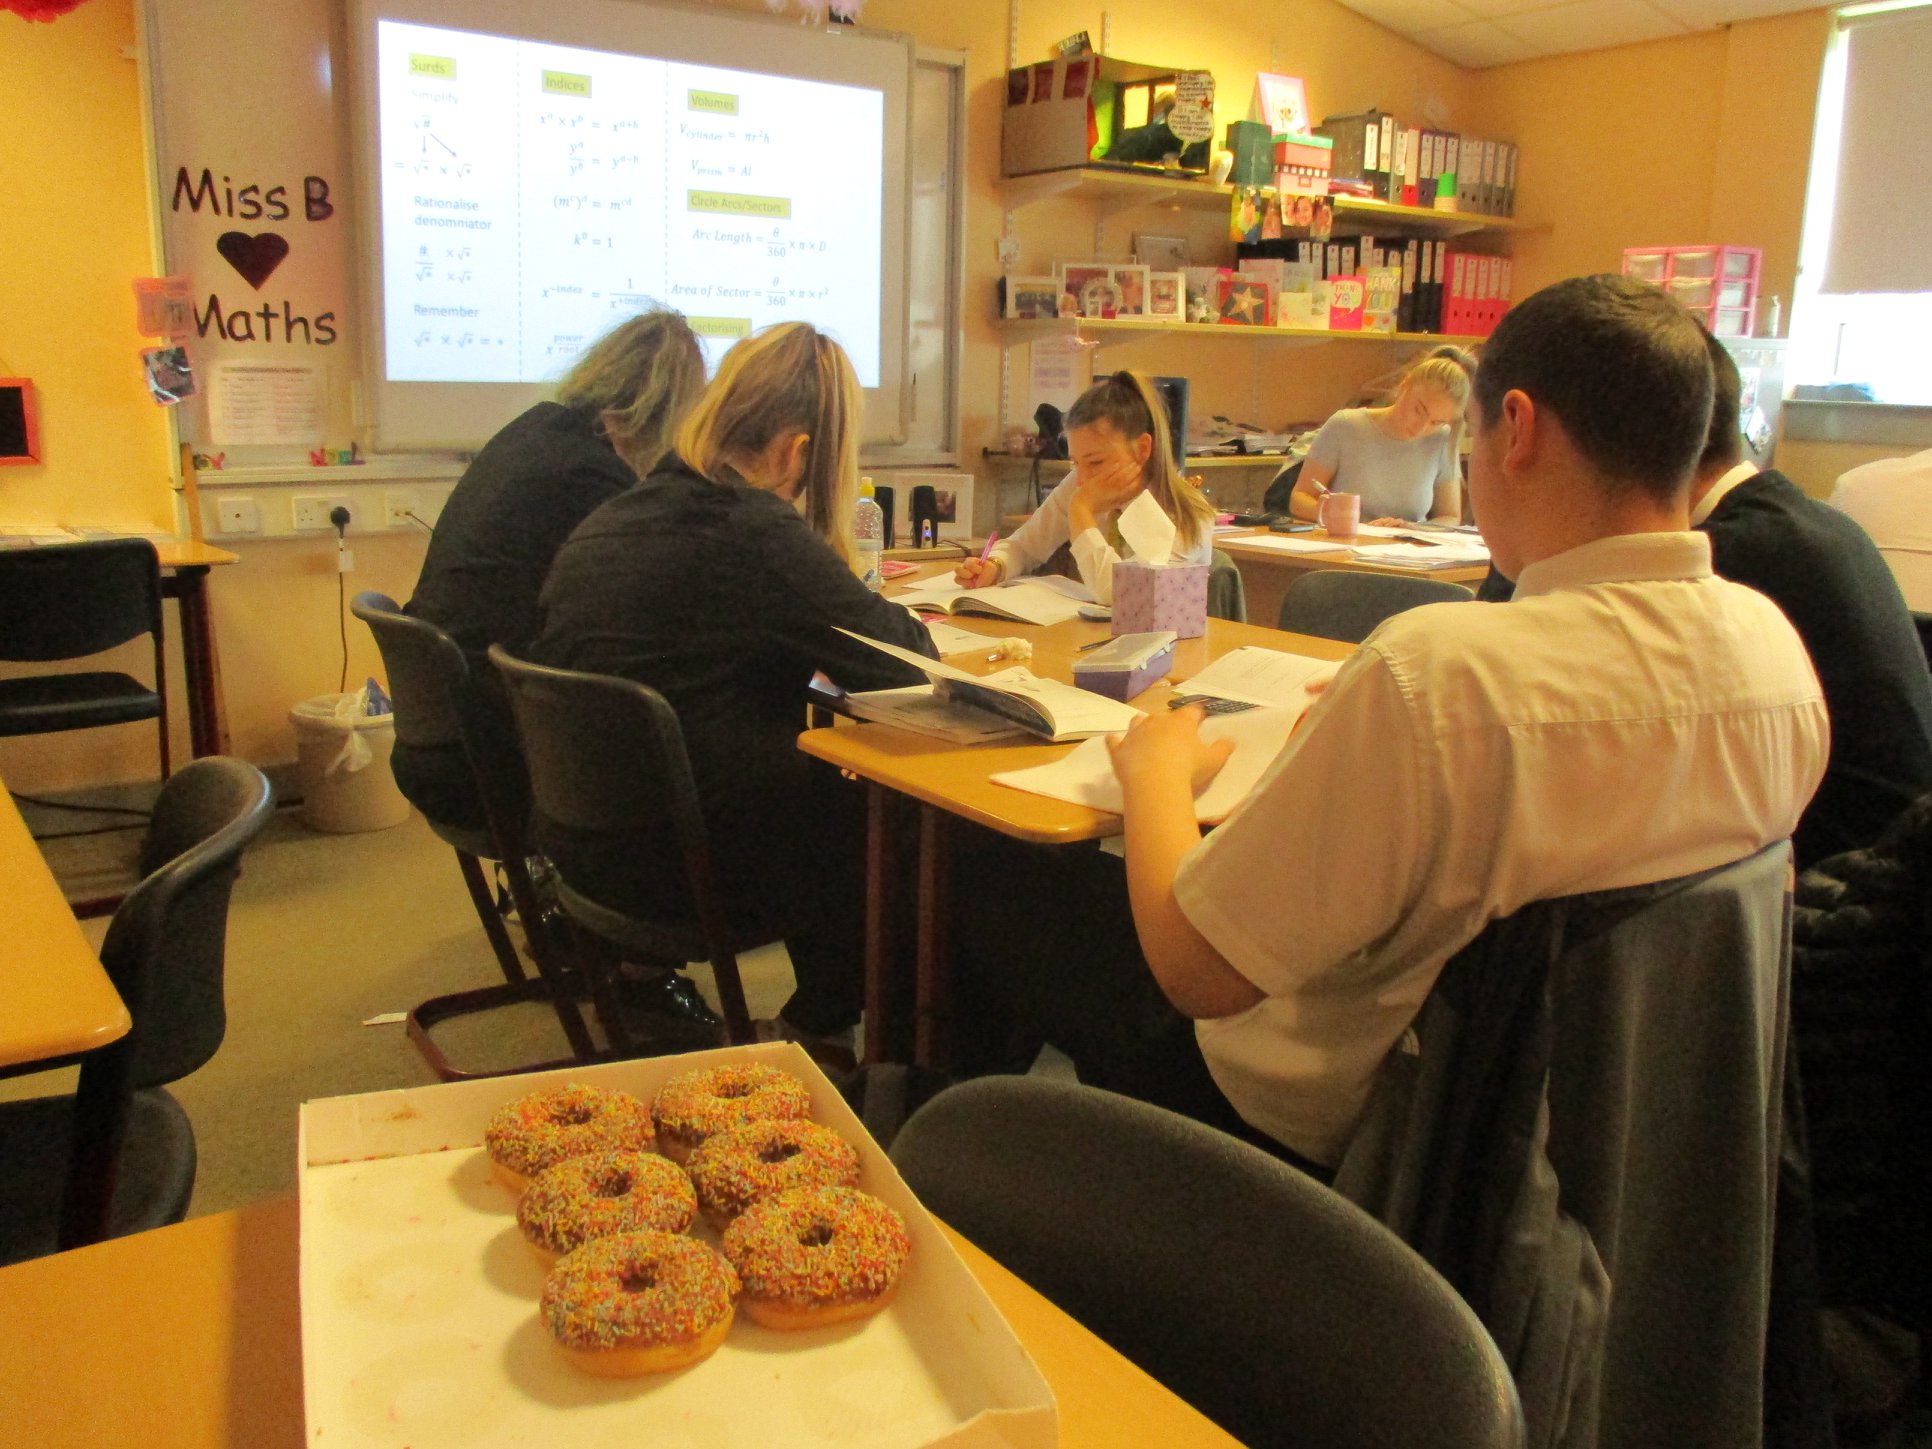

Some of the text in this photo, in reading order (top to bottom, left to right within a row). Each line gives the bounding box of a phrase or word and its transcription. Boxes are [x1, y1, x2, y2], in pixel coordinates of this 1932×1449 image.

[411, 58, 446, 74] Surds
[546, 77, 585, 92] Indices
[411, 89, 459, 104] Simplify
[691, 95, 735, 111] Volumes
[172, 166, 334, 221] Miss B
[414, 196, 479, 211] Rationalise
[690, 195, 781, 213] Circle Arcs/Sectors
[414, 215, 492, 230] denomniator
[692, 229, 711, 241] Arc
[714, 230, 751, 246] Length
[767, 247, 786, 257] 360
[671, 284, 697, 296] Area
[700, 284, 712, 298] of
[716, 285, 751, 298] Sector
[767, 295, 786, 306] 360
[414, 304, 479, 318] Remember
[192, 293, 337, 346] Maths
